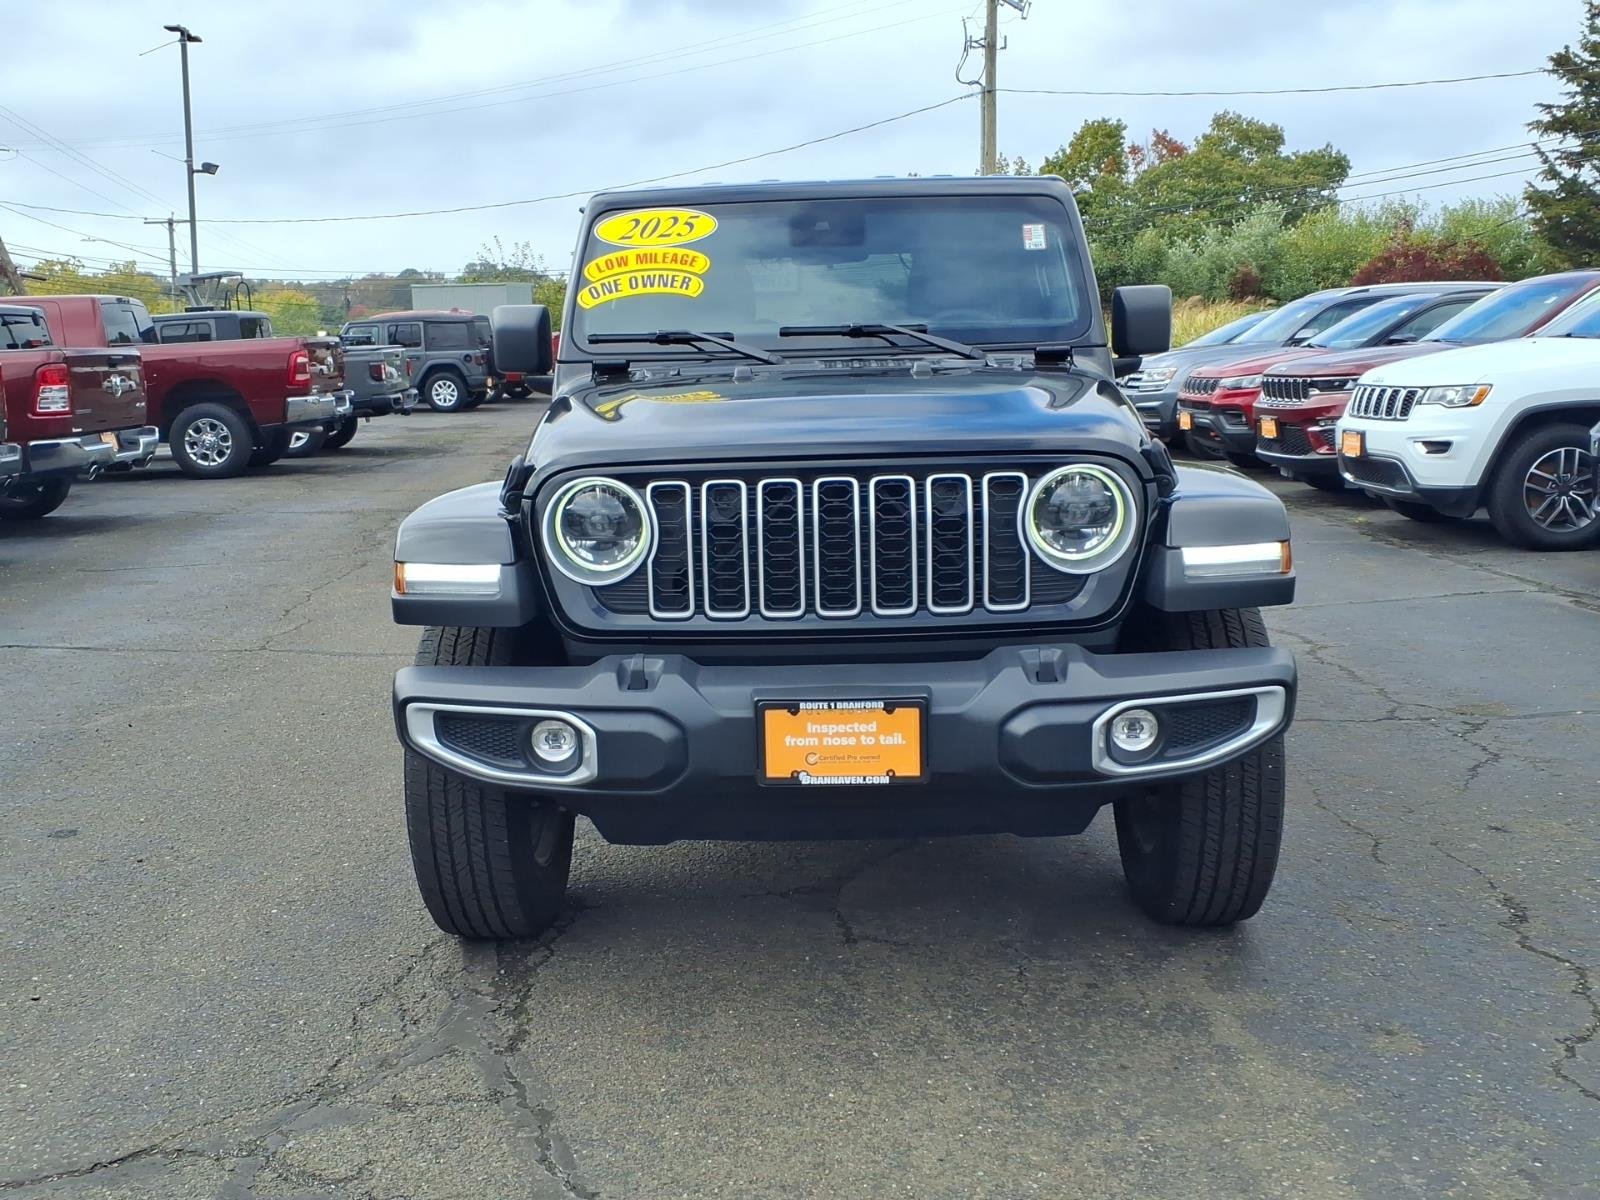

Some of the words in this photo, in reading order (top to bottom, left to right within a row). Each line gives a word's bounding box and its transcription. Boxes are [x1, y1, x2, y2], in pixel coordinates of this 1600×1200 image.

[618, 215, 700, 241] 2025
[595, 255, 629, 273] LOW
[635, 252, 698, 268] MILEAGE
[588, 278, 623, 300] ONE
[629, 274, 692, 291] OWNER
[800, 702, 828, 710] ROUTE
[829, 702, 835, 710] 1
[836, 701, 884, 710] BRANFORD
[807, 721, 877, 735] Inspected
[784, 735, 818, 746] from
[823, 735, 857, 746] nose
[860, 734, 875, 746] to
[879, 733, 906, 745] tail.
[801, 775, 890, 785] BRANHAVEN.COM
